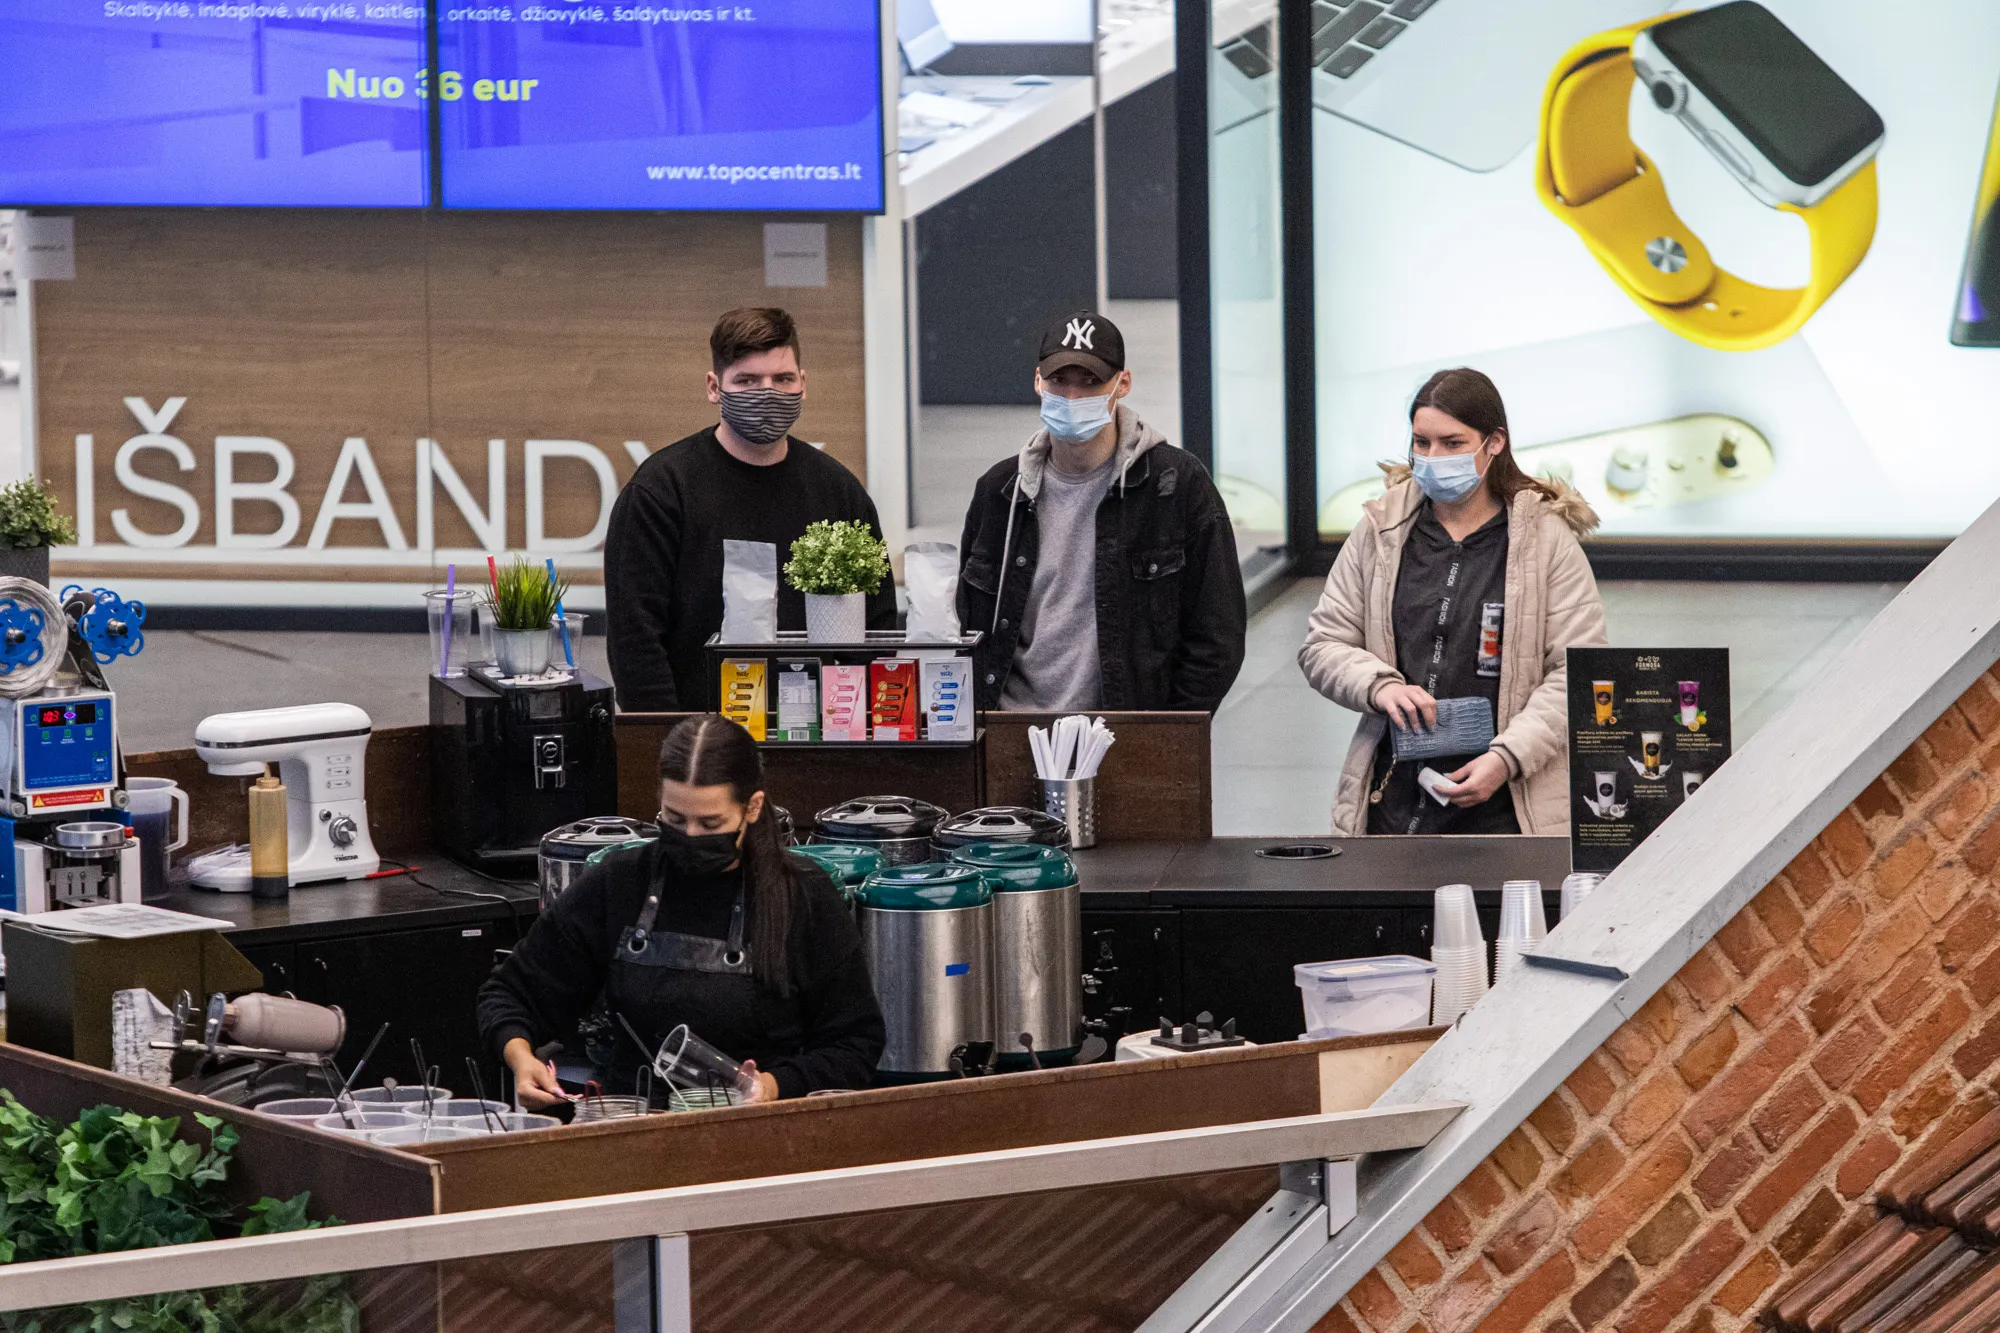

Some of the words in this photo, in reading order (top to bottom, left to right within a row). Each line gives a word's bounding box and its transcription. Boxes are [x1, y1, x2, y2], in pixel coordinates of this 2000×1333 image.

[612, 6, 713, 26] šaldytuvas
[716, 6, 732, 22] ir
[734, 6, 757, 22] kt.
[327, 67, 405, 99] Nuo
[472, 77, 539, 102] eur
[646, 162, 863, 185] www.topocentras.lt
[1061, 317, 1096, 350] NY
